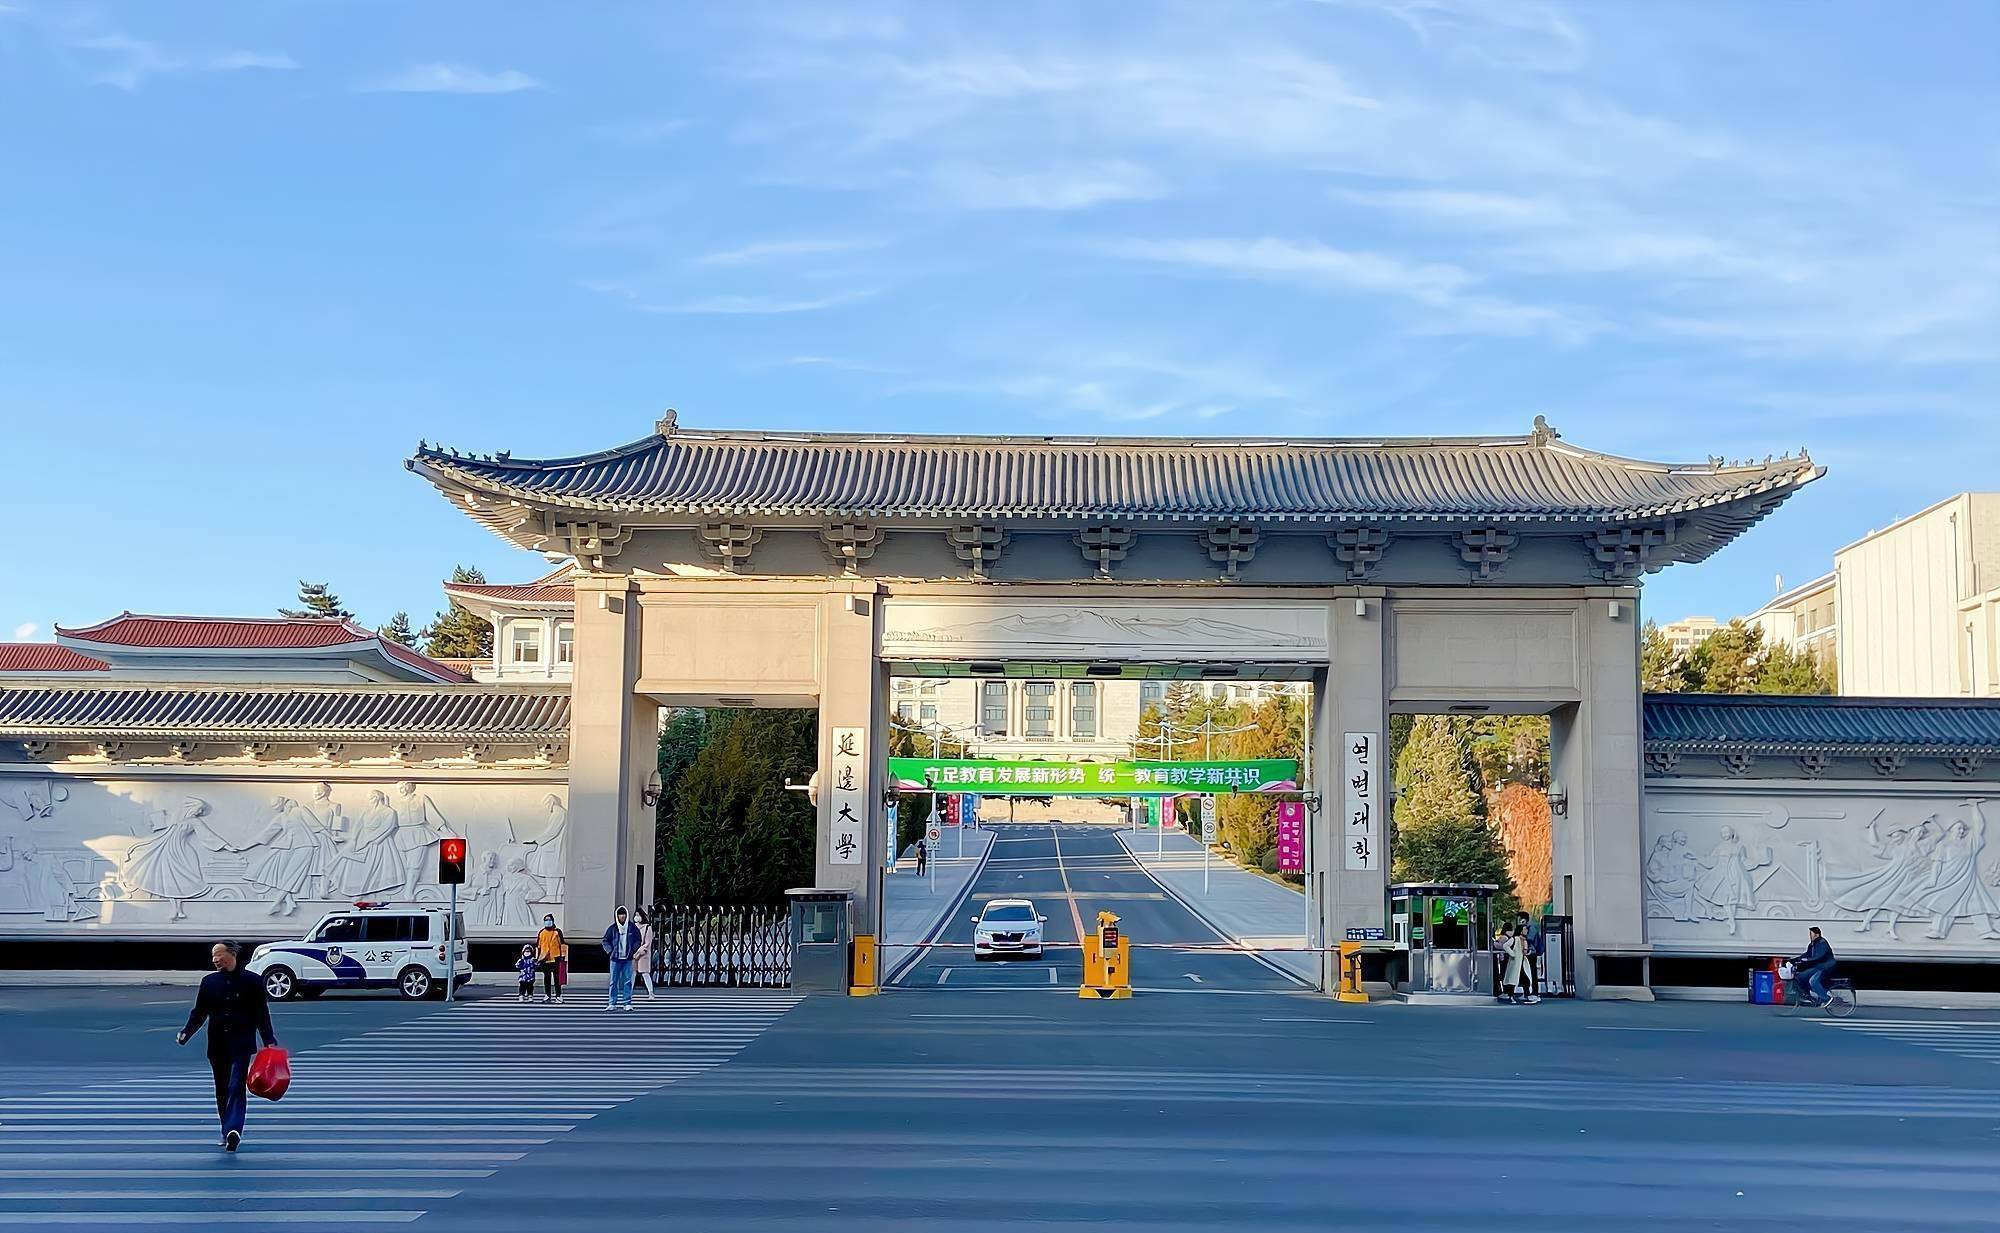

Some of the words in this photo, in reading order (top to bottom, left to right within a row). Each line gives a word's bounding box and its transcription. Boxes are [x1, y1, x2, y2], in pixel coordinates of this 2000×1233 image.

[923, 766, 1086, 784] 立足教育发展新形势
[1098, 767, 1261, 785] 统一教育教学新共识
[1351, 735, 1370, 869] 연변대학
[364, 949, 393, 962] 公安
